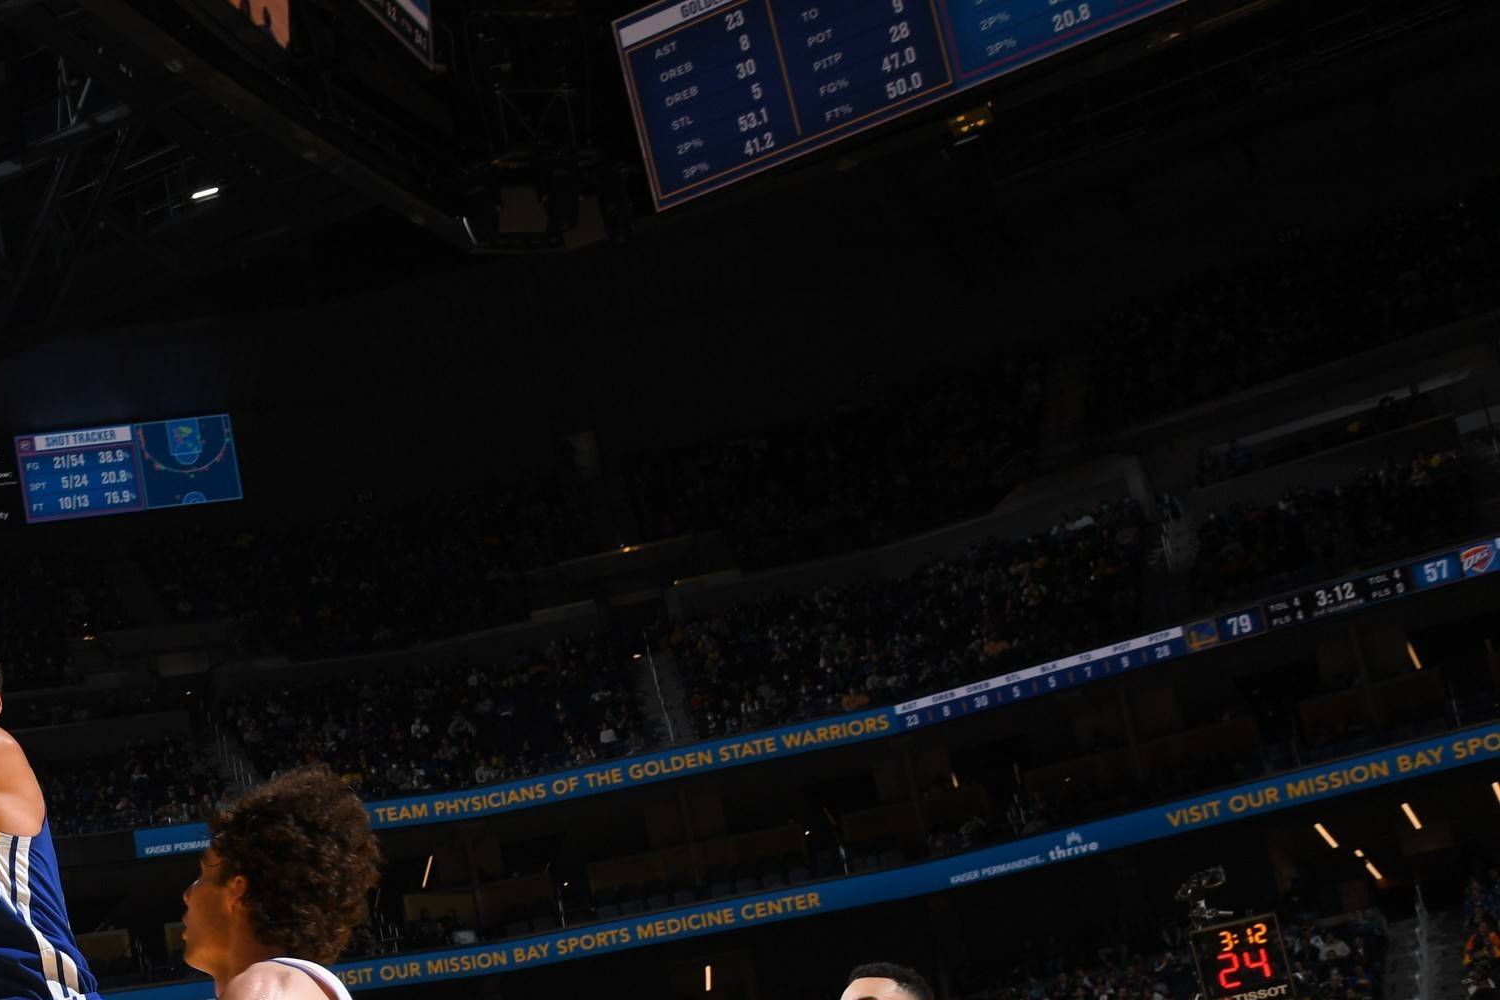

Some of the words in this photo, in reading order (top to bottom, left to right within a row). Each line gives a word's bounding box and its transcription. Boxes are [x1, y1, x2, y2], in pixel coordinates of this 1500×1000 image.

[801, 8, 819, 23] TO
[1051, 3, 1092, 34] 20.8
[654, 41, 677, 59] AST
[725, 10, 745, 31] 23
[807, 28, 833, 48] POT
[888, 21, 911, 43] 28
[660, 61, 694, 83] OREB
[739, 34, 750, 51] 8
[881, 46, 917, 73] 47.0
[665, 86, 699, 108] DREB
[735, 58, 757, 80] 30
[885, 72, 923, 100] 50.0
[671, 115, 695, 131] STL
[751, 82, 763, 100] 5
[737, 107, 769, 133] 53.1
[743, 131, 775, 157] 41.2
[45, 434, 70, 448] SHOT
[73, 429, 117, 445] TRACKER
[52, 453, 85, 470] 21/54
[60, 474, 89, 490] 5/24
[32, 503, 44, 512] FT
[58, 495, 90, 510] 10/13
[1423, 560, 1449, 583] 57
[1315, 582, 1357, 608] 3:12
[1227, 614, 1253, 636] 79
[906, 714, 920, 727] 23
[375, 803, 429, 823] TEAM
[434, 783, 547, 816] PHYSICIANS
[552, 776, 580, 796] OF
[584, 767, 625, 789] THE
[628, 749, 713, 781] GOLDEN
[718, 736, 778, 763] STATE
[782, 714, 890, 750] WARRIORS
[1166, 800, 1222, 828] VISIT
[1228, 787, 1281, 814] OUR
[1286, 760, 1390, 800] MISSION
[1396, 747, 1444, 773] BAY
[1049, 841, 1099, 862] thrive
[379, 960, 422, 981] OUR
[427, 950, 508, 977] MISSION
[513, 942, 550, 964] BAY
[556, 928, 632, 956] SPORTS
[636, 907, 736, 941] MEDICINE
[740, 892, 821, 920] CENTER
[1217, 922, 1268, 952] 3:12
[1216, 948, 1273, 989] 24
